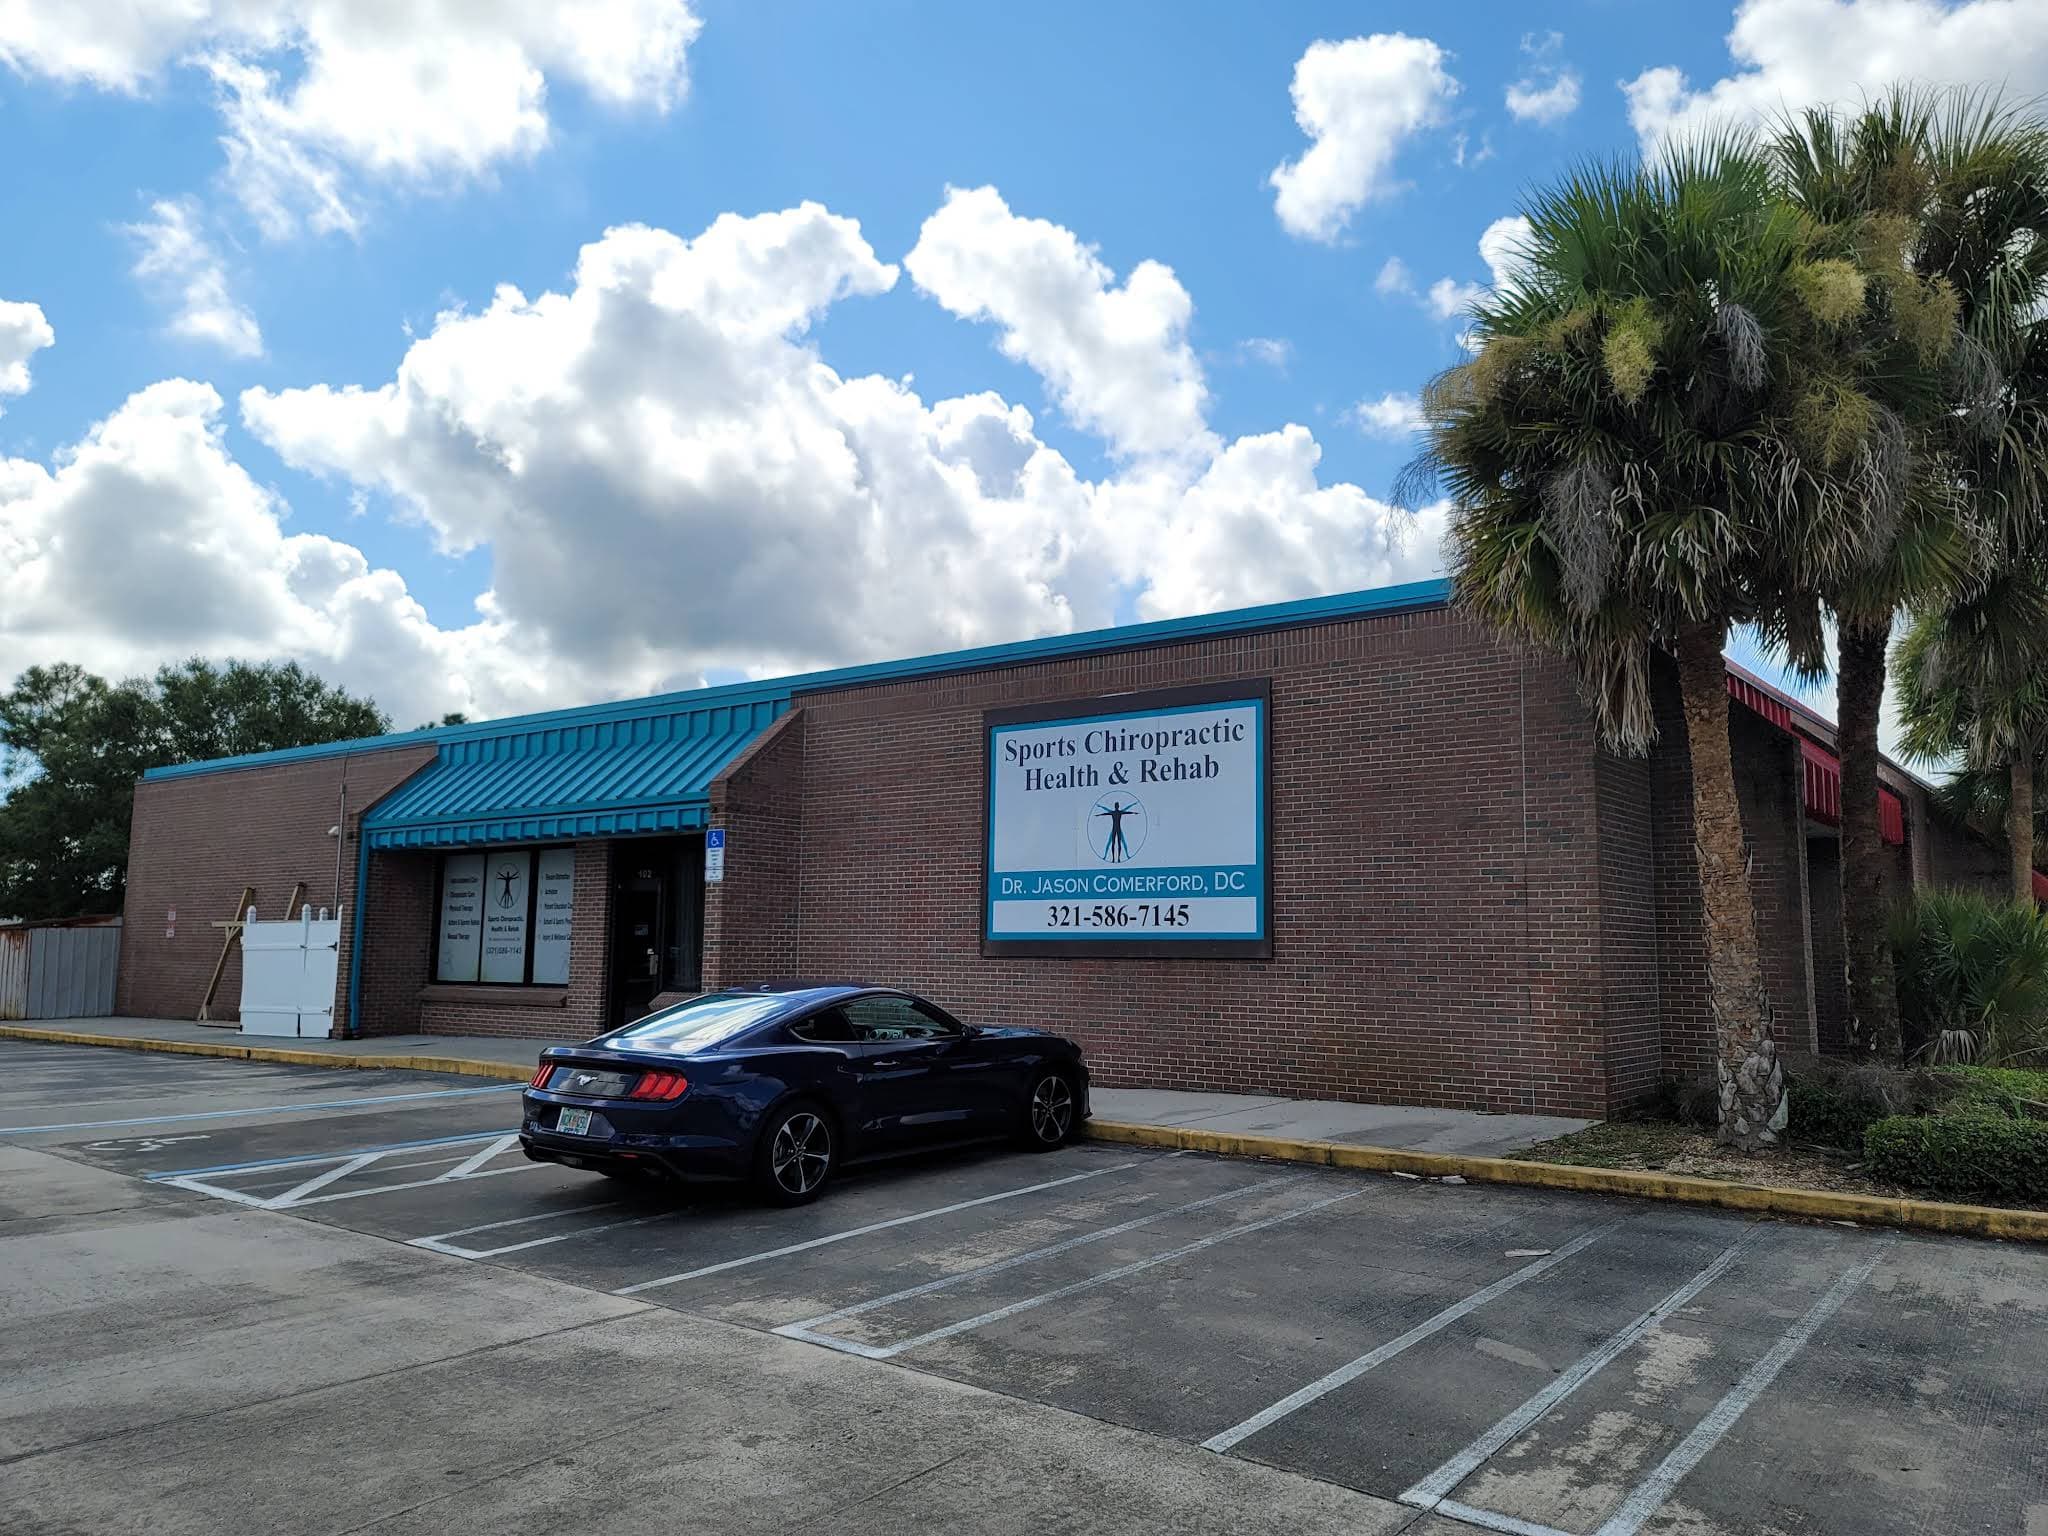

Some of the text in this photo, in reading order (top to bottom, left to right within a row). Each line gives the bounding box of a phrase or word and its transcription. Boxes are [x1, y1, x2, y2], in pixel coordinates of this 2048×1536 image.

[1005, 718, 1246, 766] Sports Chiropractic
[1025, 755, 1220, 791] Health & Rehab
[1002, 871, 1246, 894] DR. JASON COMERFORD, DC
[1047, 904, 1190, 927] 321-586-7145
